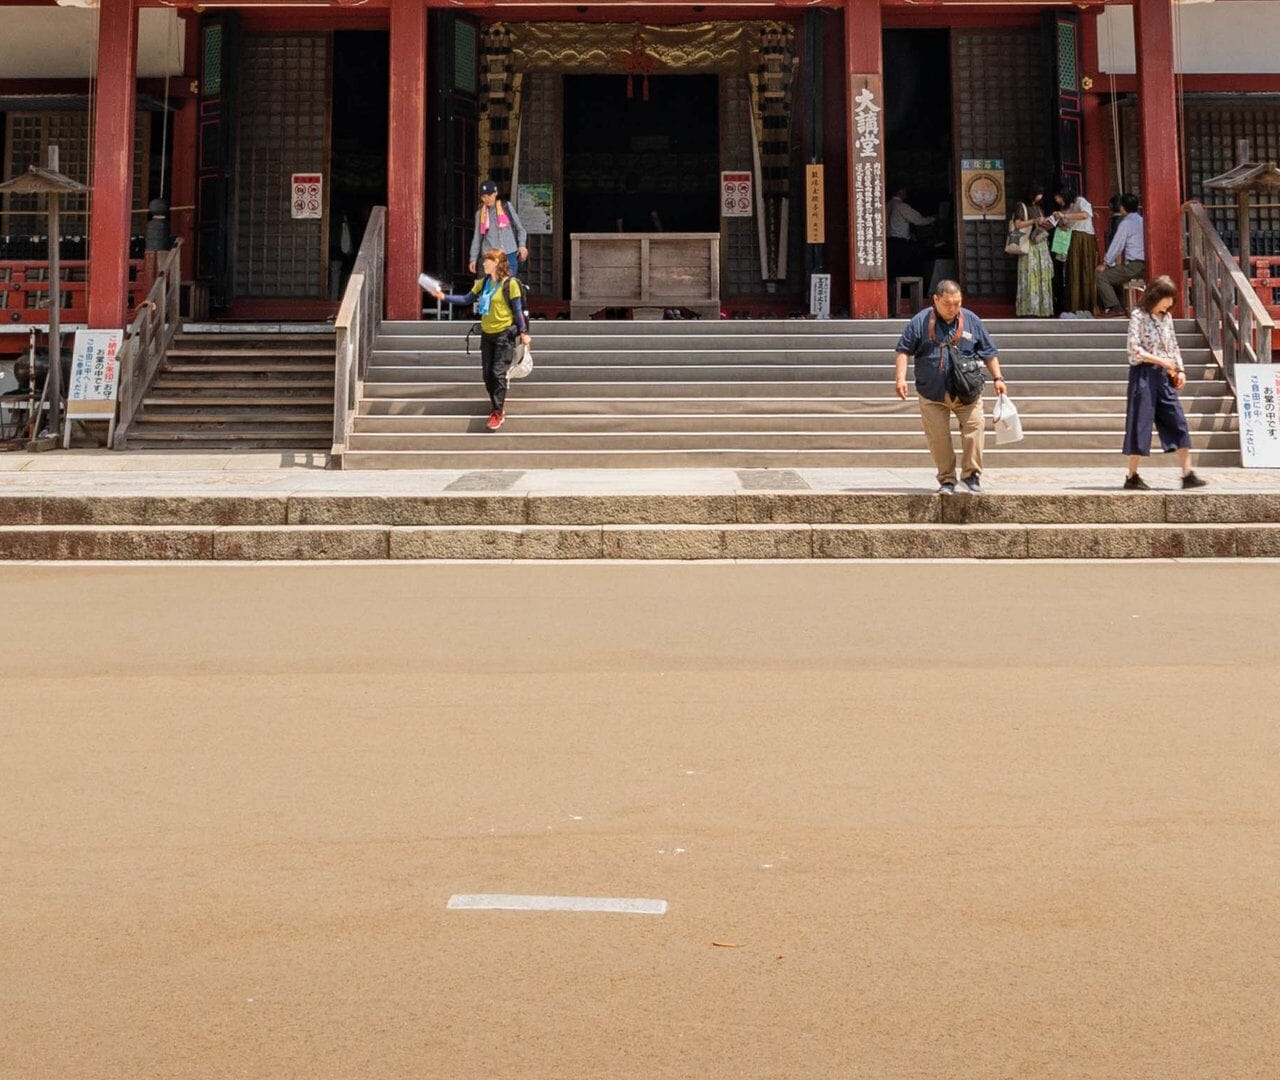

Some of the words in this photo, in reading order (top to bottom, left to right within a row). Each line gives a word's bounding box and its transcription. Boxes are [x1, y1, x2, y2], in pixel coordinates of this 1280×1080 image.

[855, 88, 881, 157] 大講堂
[94, 349, 105, 394] お堂の中です。
[1263, 387, 1278, 440] お堂の中です。
